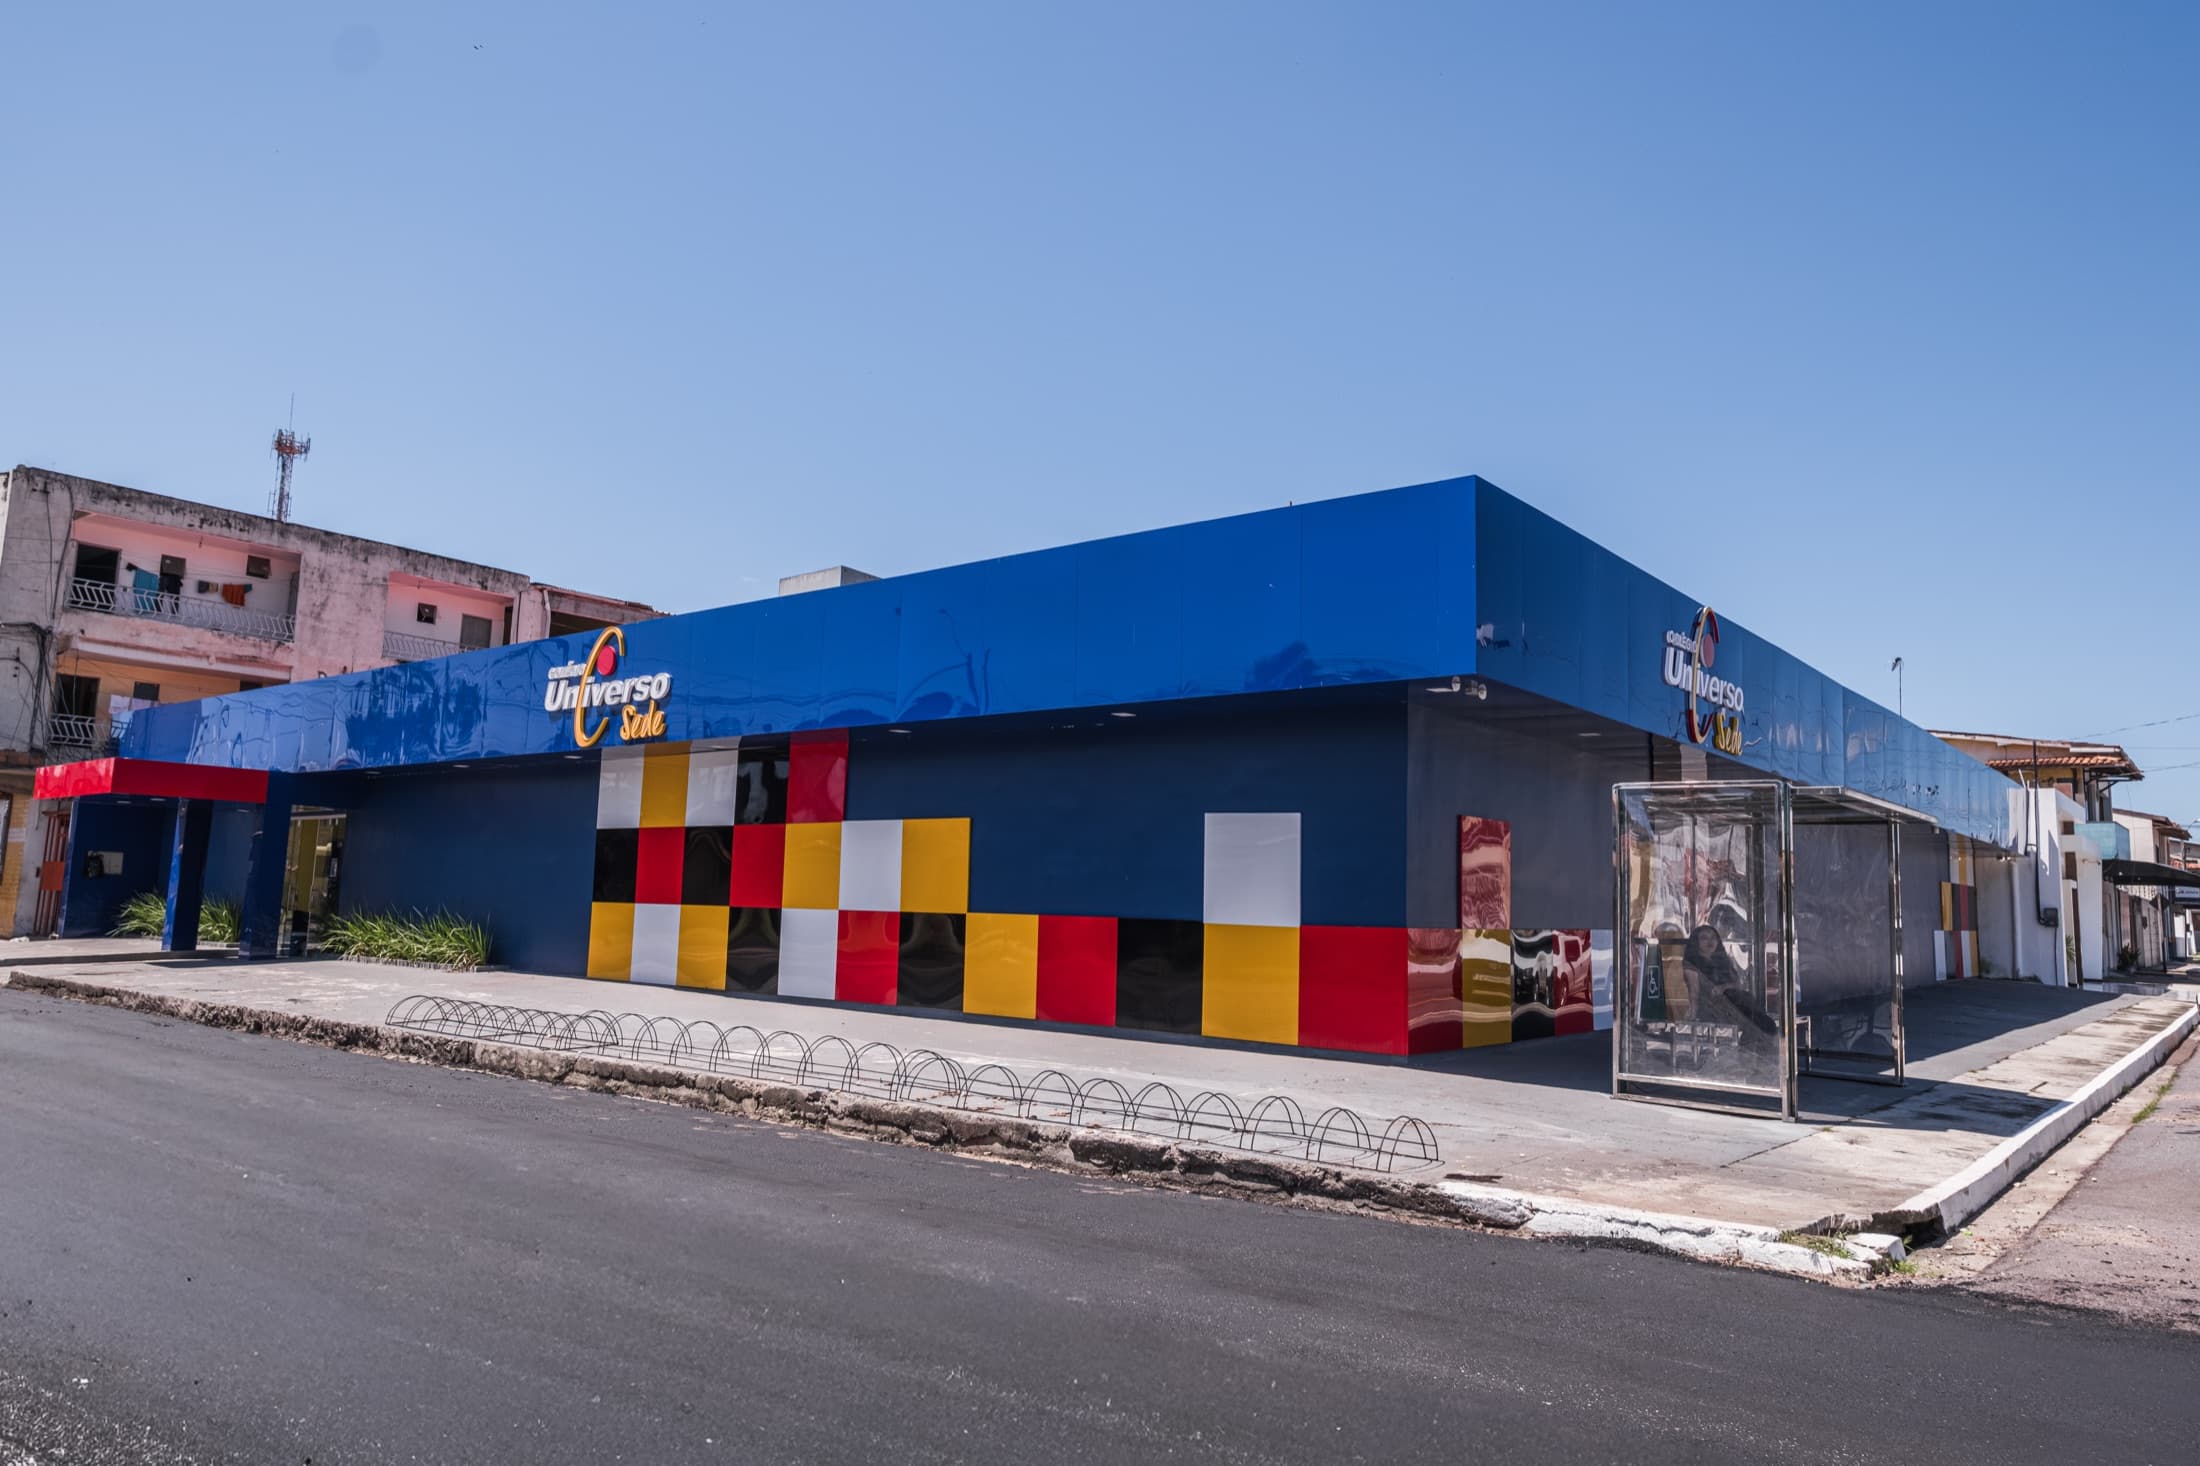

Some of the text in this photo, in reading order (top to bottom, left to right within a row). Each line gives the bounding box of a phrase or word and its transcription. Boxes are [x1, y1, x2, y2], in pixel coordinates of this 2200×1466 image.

[544, 672, 672, 712] Universo
[1664, 647, 1744, 713] Universo
[619, 700, 667, 741] Sede
